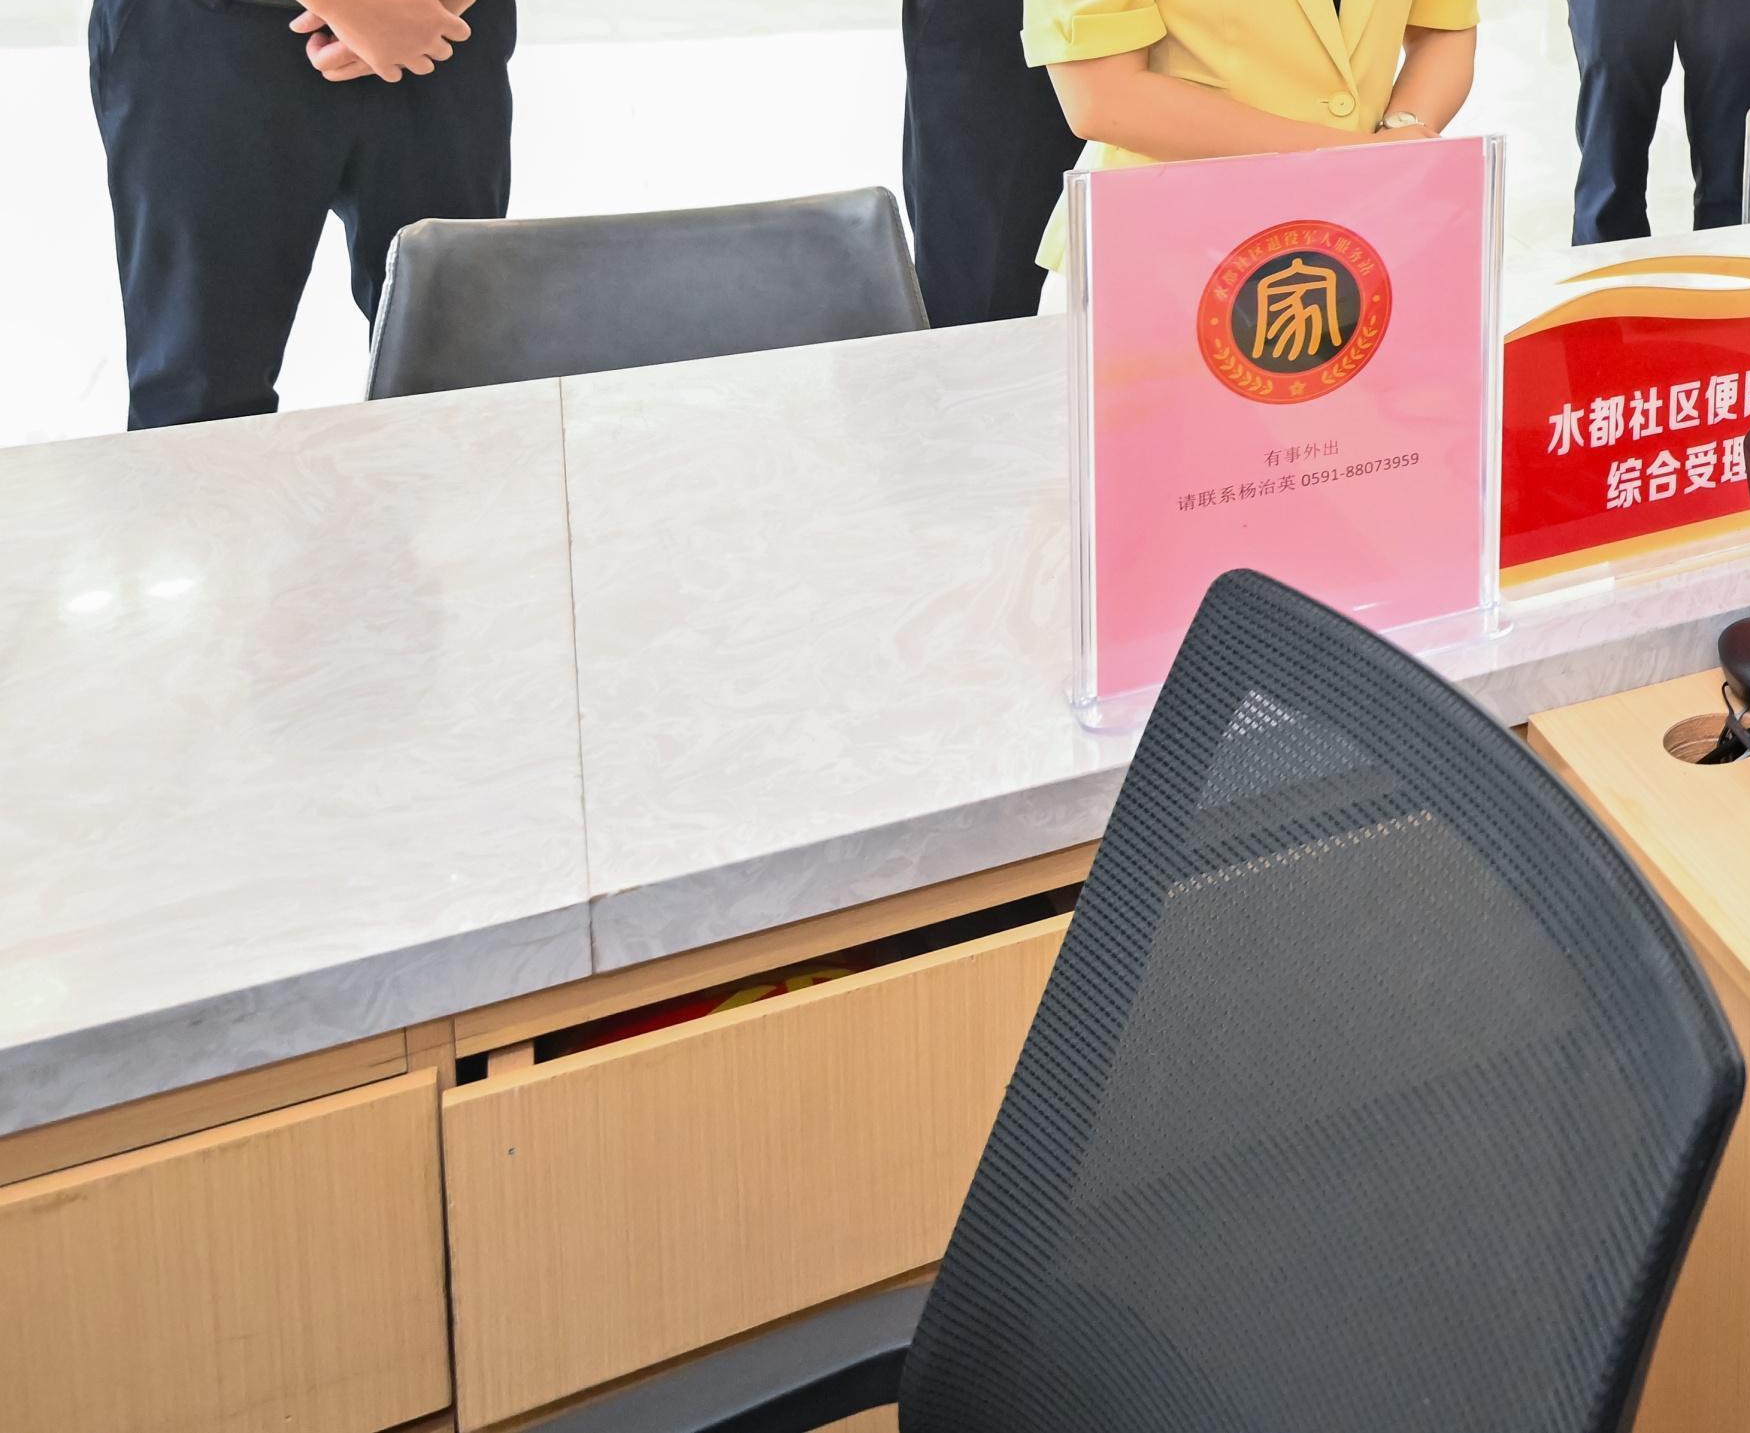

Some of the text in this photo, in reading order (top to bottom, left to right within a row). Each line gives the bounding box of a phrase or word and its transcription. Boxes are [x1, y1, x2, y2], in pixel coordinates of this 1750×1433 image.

[1213, 229, 1376, 300] 水都社区退役军人服务站
[1177, 452, 1420, 512] 请联系杨治英 0591-88073959
[1264, 439, 1339, 468] 有事外出
